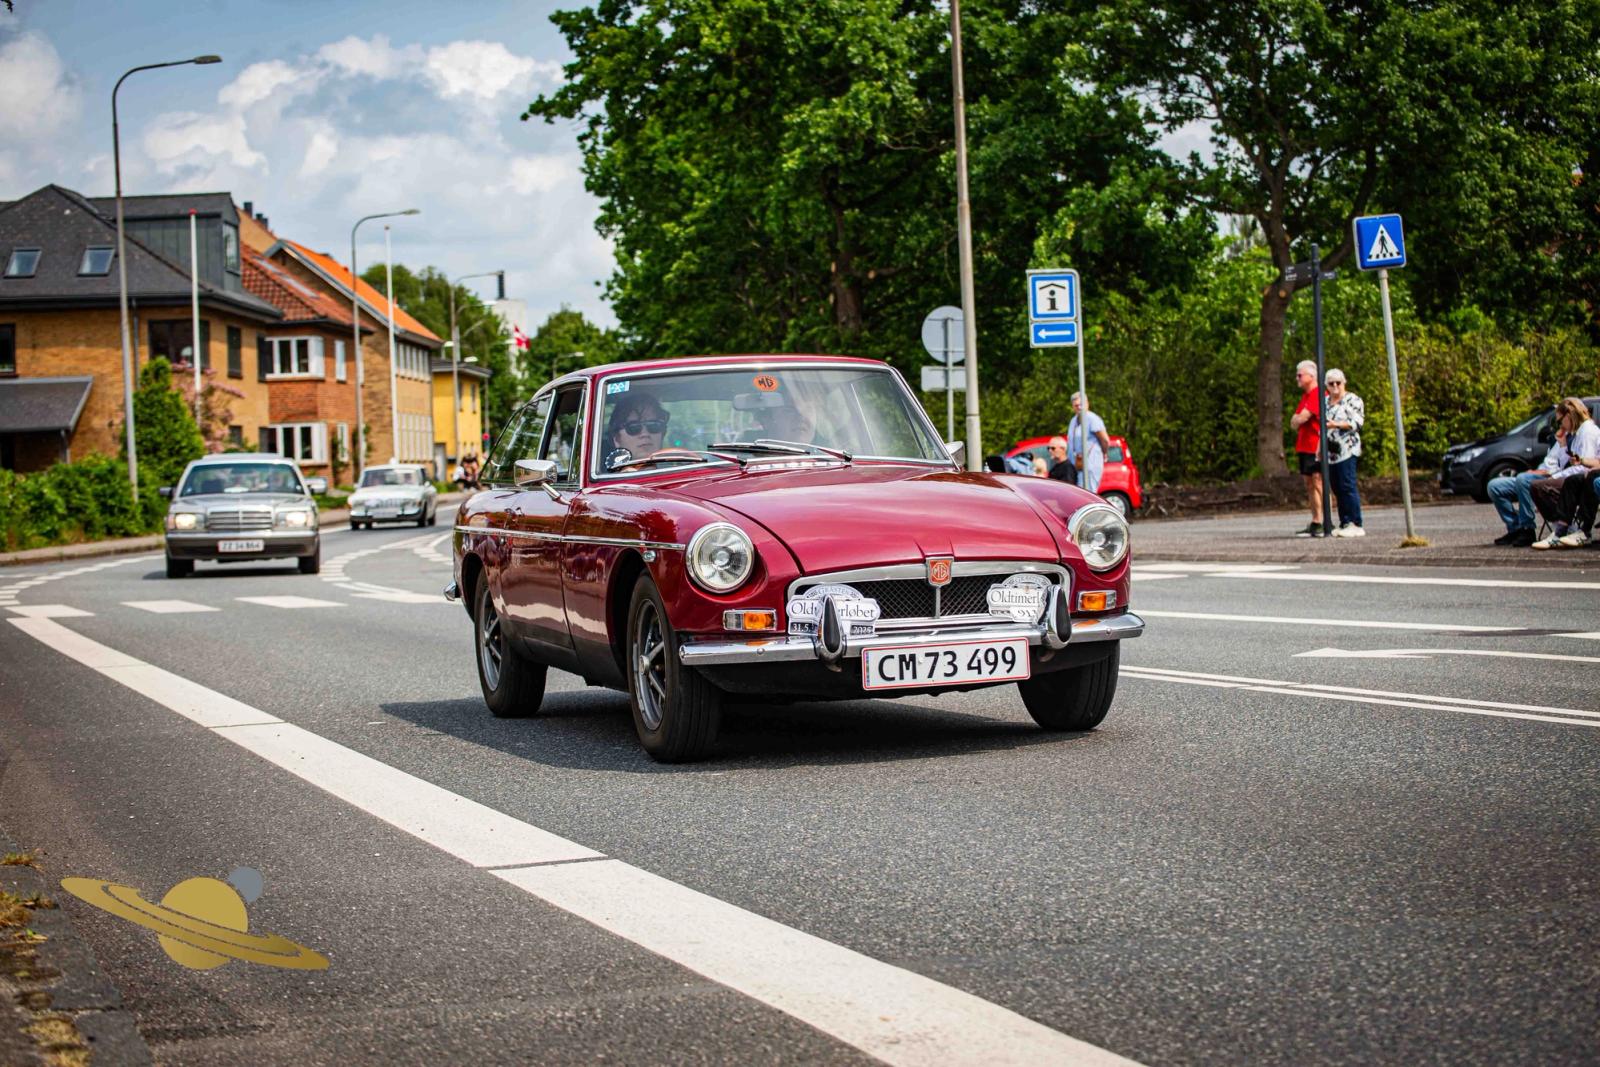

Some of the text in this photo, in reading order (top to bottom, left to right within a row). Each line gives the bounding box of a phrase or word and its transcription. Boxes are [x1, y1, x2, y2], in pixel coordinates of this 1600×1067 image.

[932, 563, 948, 579] MG
[991, 590, 1040, 604] Oldtimerl
[878, 646, 1016, 682] CM 73 499
